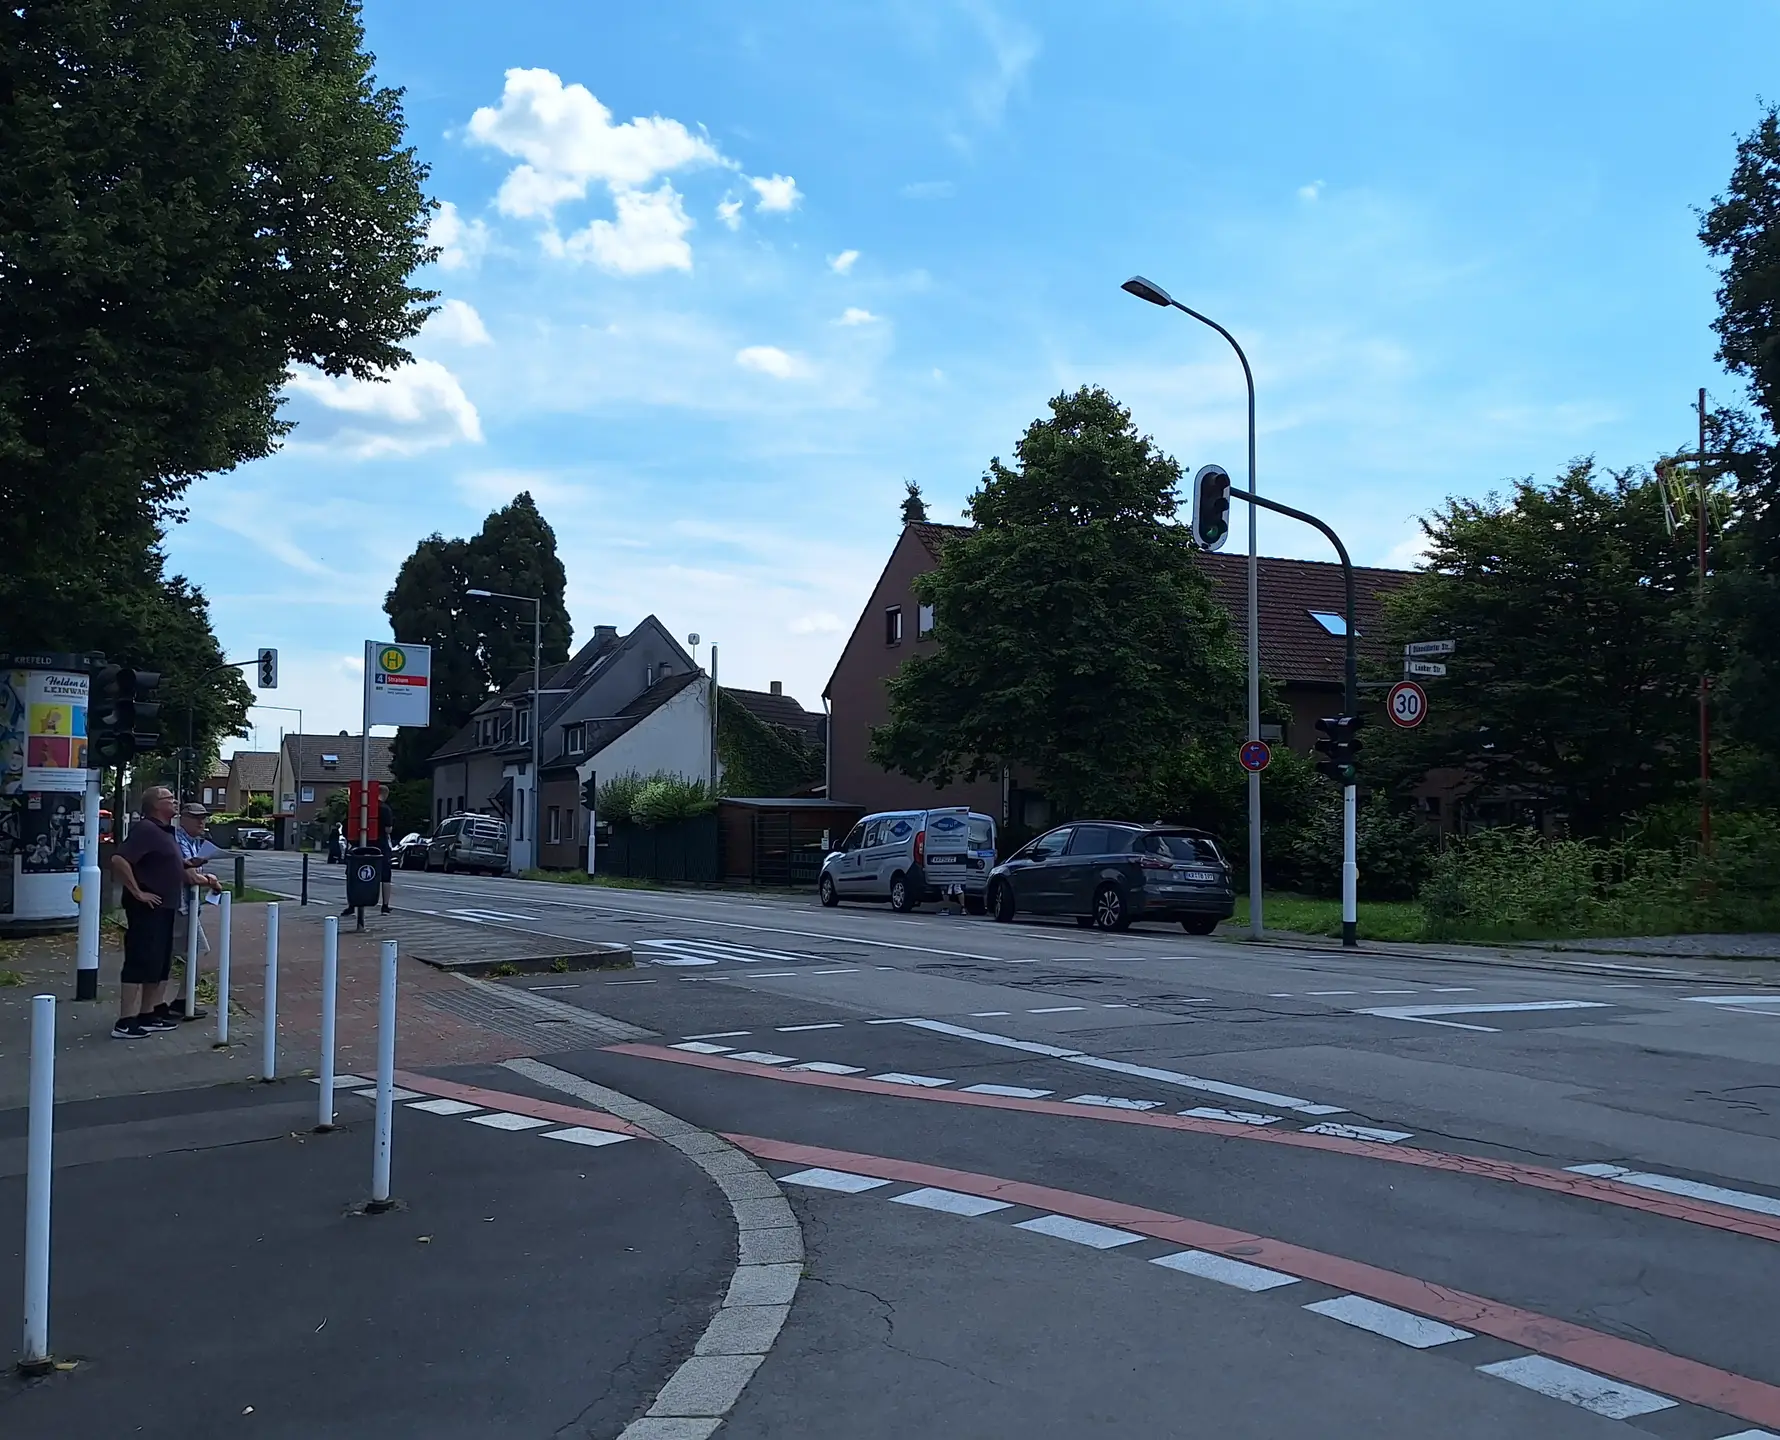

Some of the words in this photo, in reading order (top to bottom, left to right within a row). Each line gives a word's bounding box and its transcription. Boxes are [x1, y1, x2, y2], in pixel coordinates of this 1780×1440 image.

[14, 656, 52, 665] KREFELD
[45, 675, 78, 687] Helden
[377, 674, 384, 683] 4
[1396, 693, 1418, 715] 30
